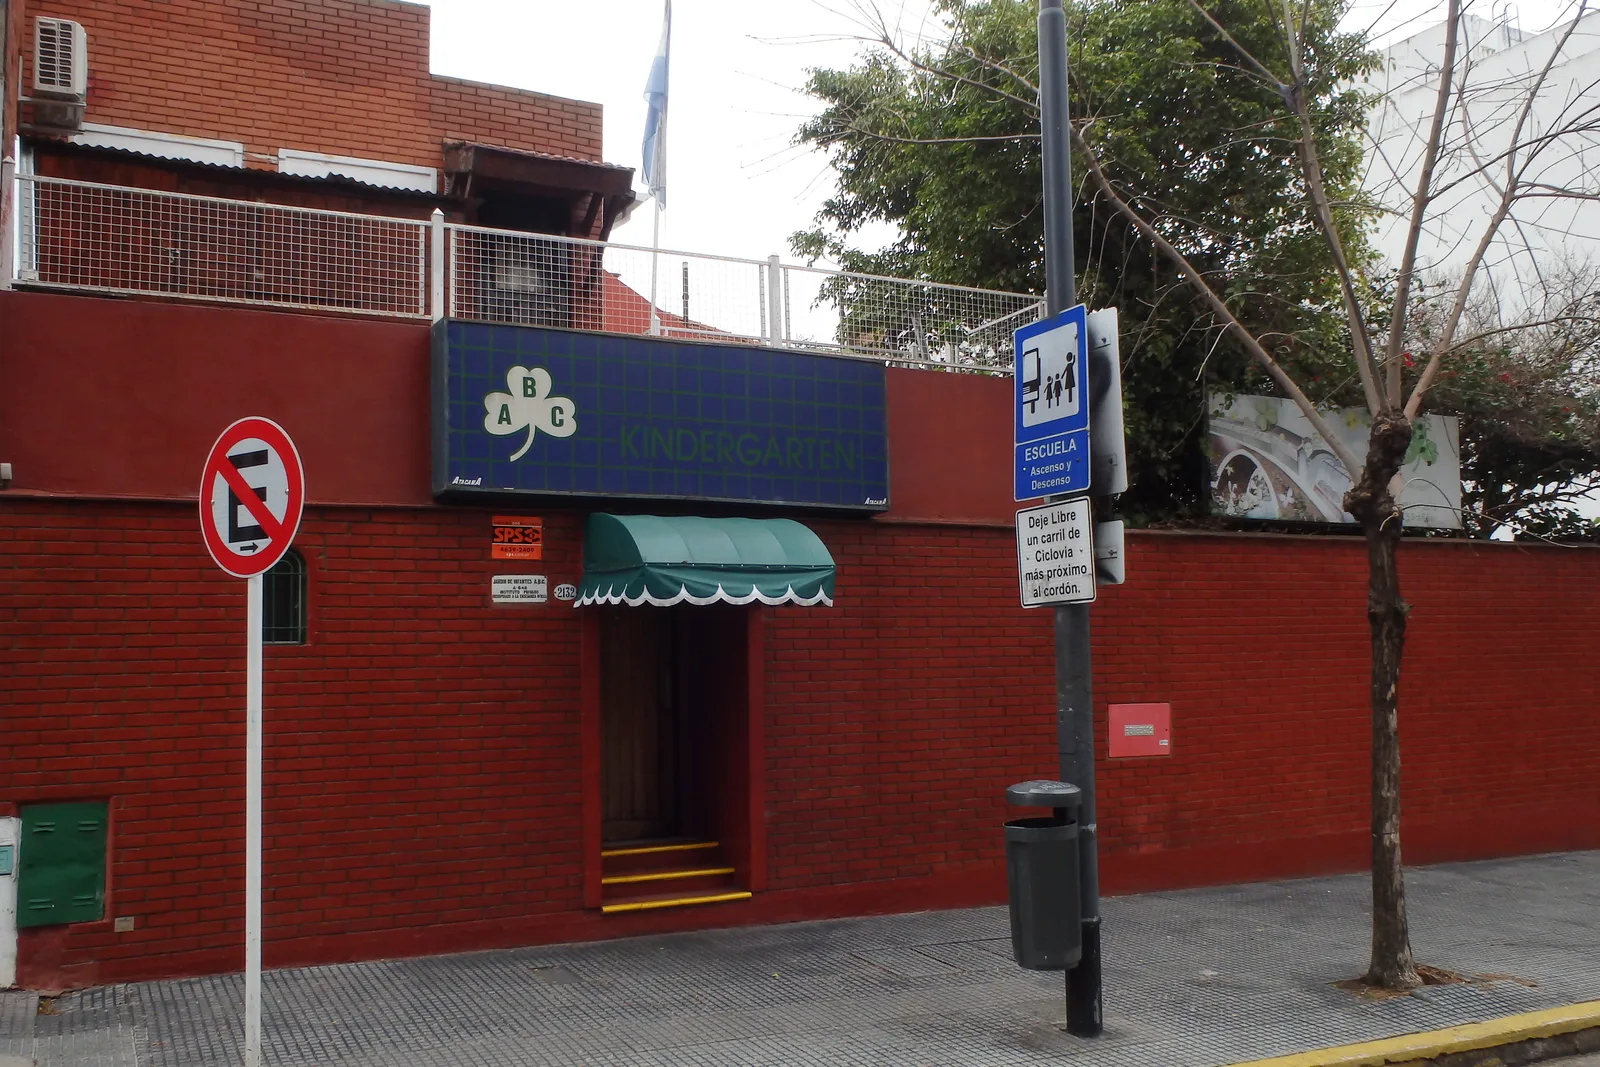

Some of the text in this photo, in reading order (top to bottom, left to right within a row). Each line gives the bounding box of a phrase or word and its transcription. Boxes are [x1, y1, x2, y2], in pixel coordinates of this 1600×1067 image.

[497, 377, 565, 427] A B C
[620, 424, 855, 472] KINDERGARTEN
[1025, 439, 1077, 461] ESCUELA
[1030, 461, 1072, 477] Ascenso y
[1031, 475, 1071, 490] Descenso
[228, 449, 269, 543] E
[1028, 511, 1077, 529] Deje Libre
[494, 528, 524, 542] SPS
[1027, 528, 1081, 547] un carril de
[1025, 564, 1087, 583] más próximo
[557, 587, 575, 598] 2132
[1033, 582, 1081, 598] al cordón.
